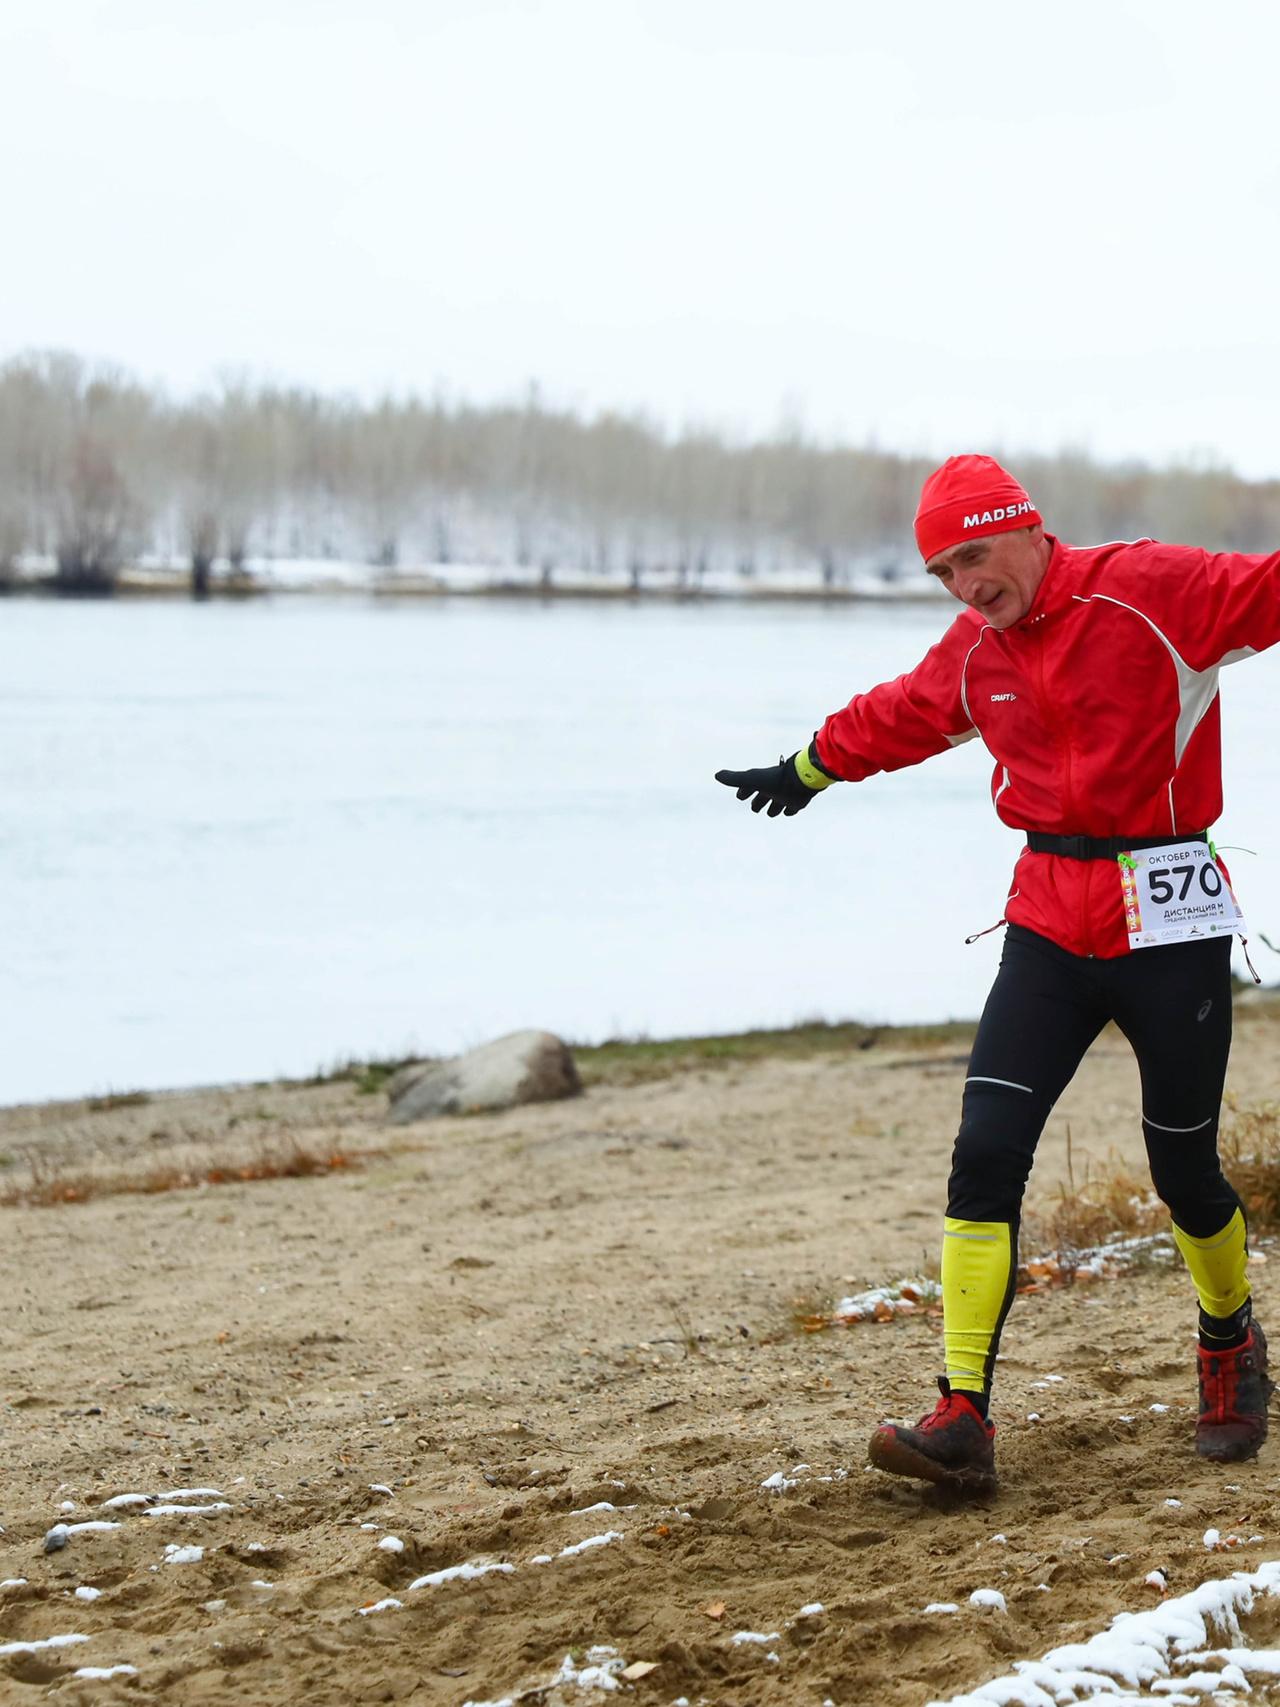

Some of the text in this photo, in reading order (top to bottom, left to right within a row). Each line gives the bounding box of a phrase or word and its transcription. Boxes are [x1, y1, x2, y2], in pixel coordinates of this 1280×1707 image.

[991, 693, 1011, 702] CRAFT
[1149, 850, 1206, 864] ОКТОБЕР ТРЕ
[1149, 862, 1222, 904] 570
[1122, 865, 1138, 931] TAIGA TRAIL SERIE
[1164, 904, 1216, 918] ДИСТАНЦИЯ
